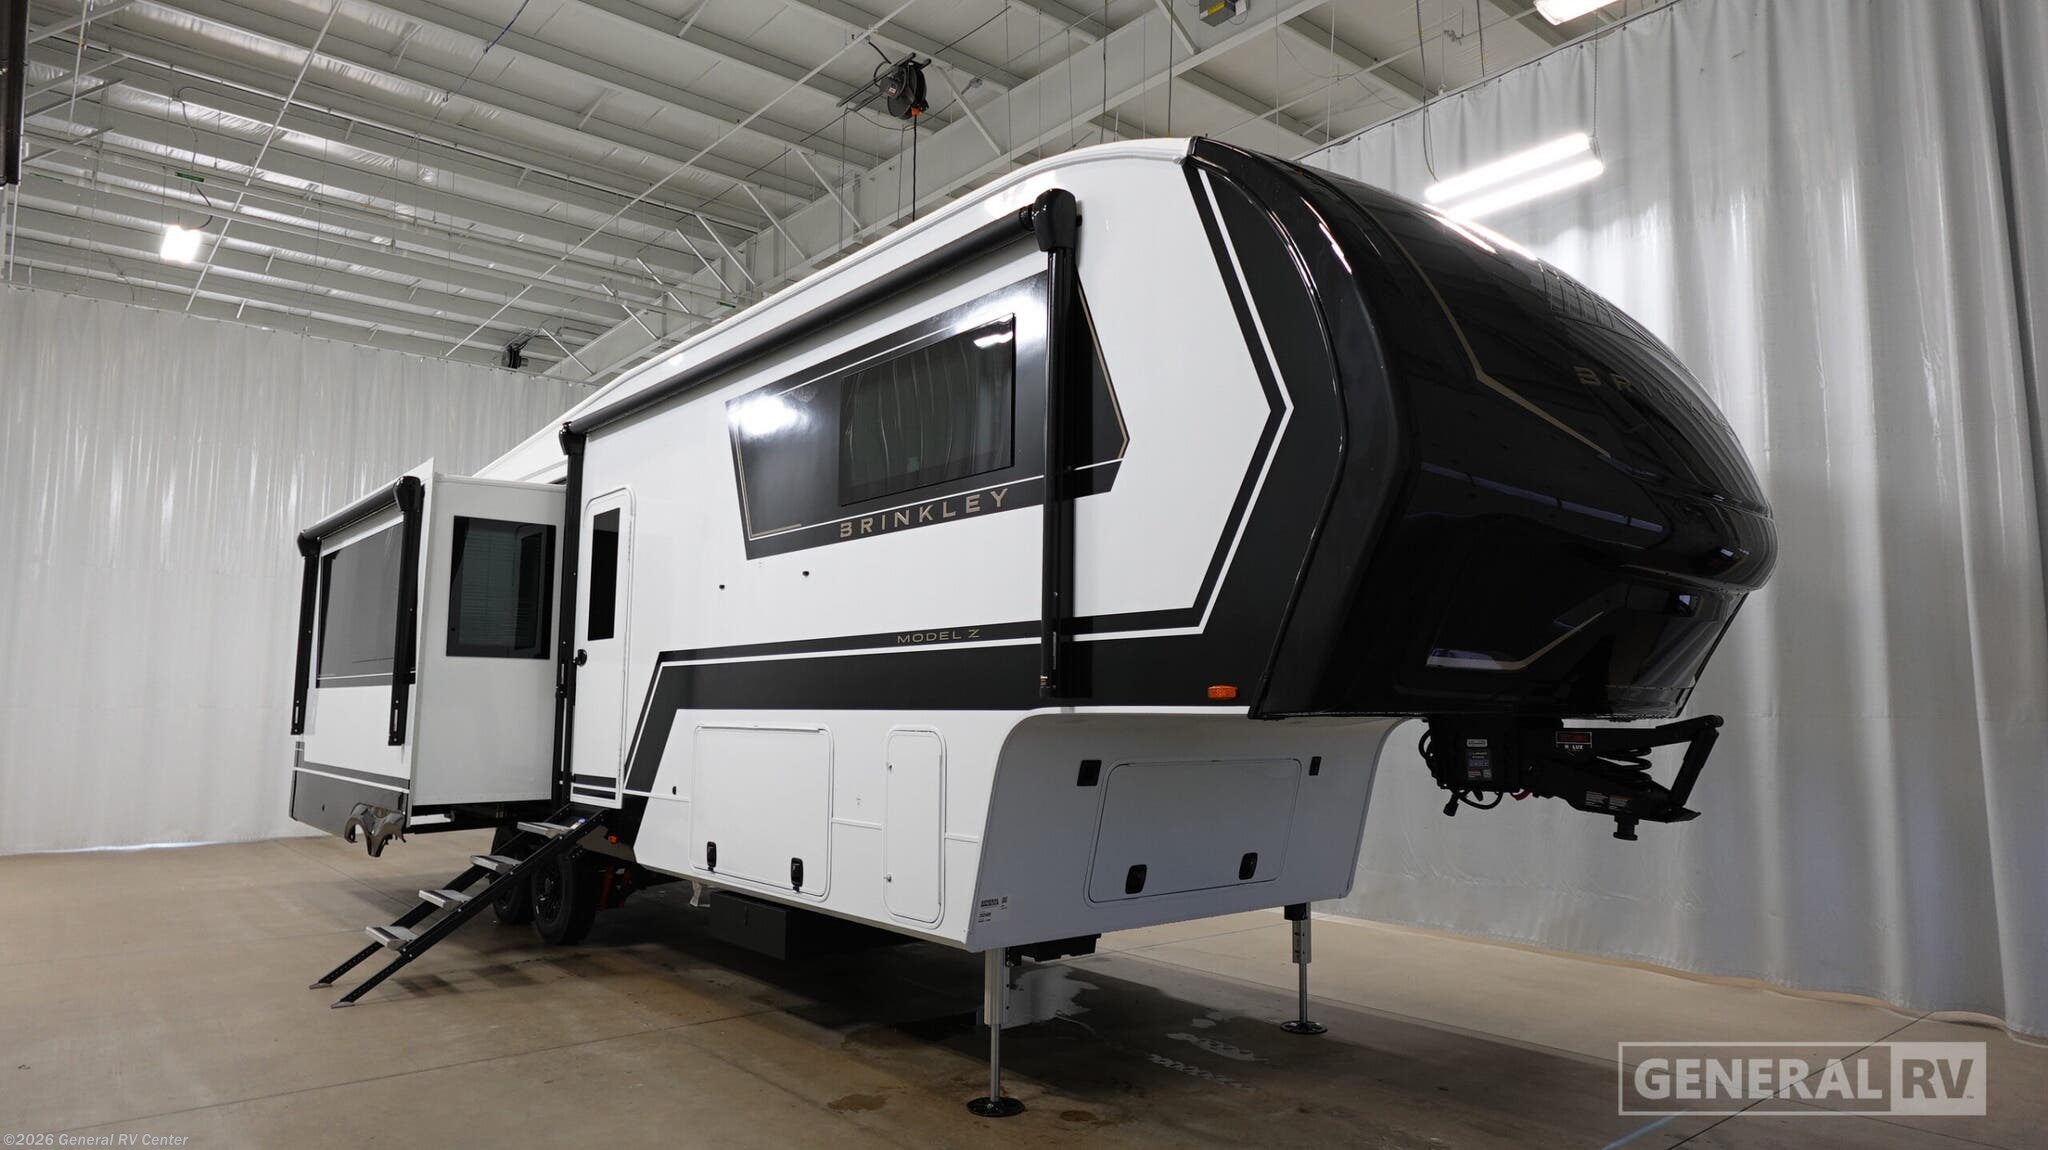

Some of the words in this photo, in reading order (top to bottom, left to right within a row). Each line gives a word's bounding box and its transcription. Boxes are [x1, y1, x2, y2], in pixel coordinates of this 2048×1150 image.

[839, 488, 1008, 538] BRINKLEY
[897, 631, 962, 644] MODEL
[968, 628, 980, 639] Z
